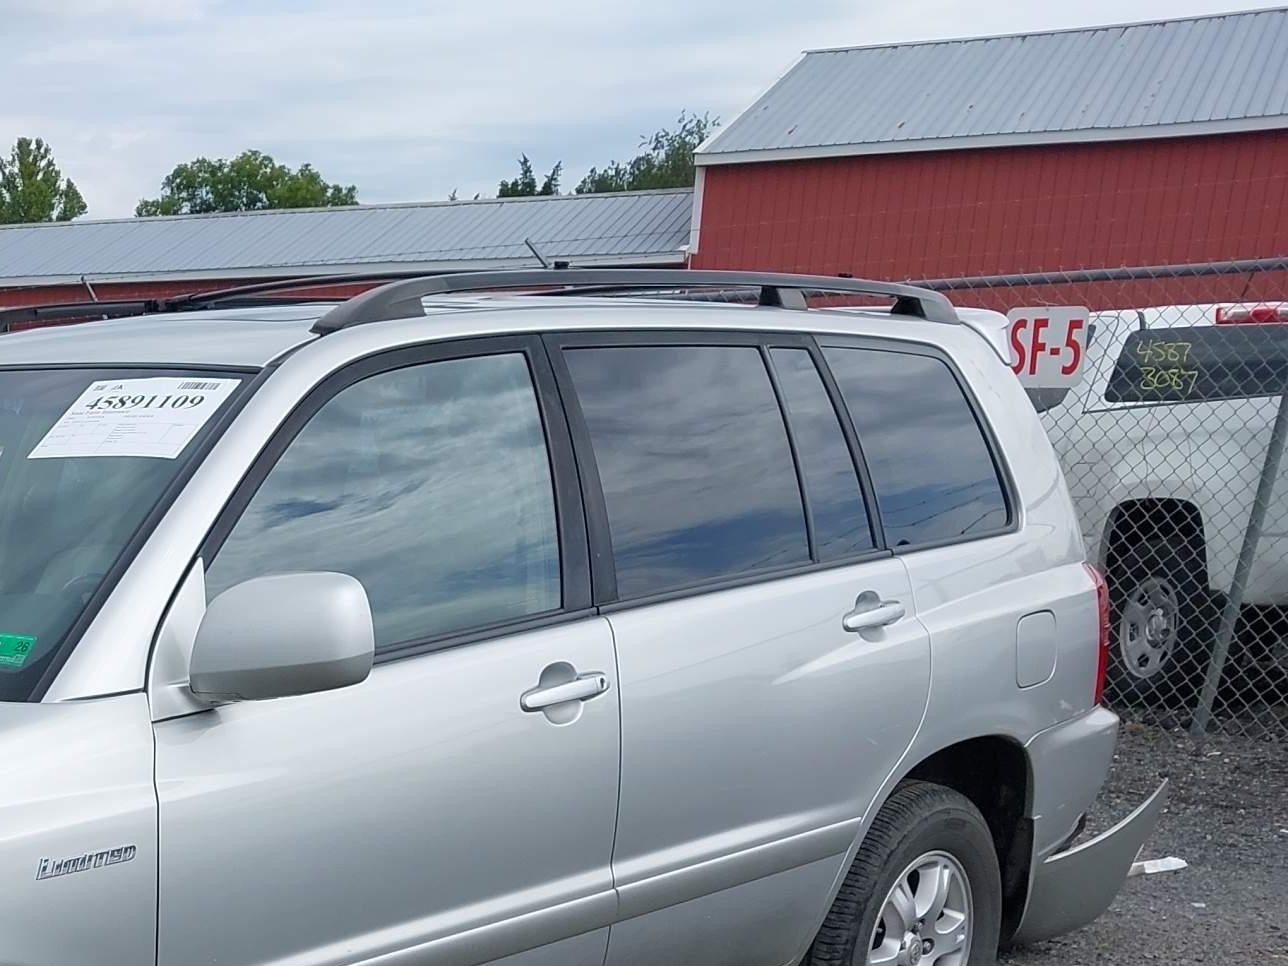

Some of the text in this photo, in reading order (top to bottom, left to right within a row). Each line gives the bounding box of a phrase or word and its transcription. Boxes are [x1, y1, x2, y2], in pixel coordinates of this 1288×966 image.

[1011, 317, 1085, 376] SF-5
[1137, 340, 1192, 363] 4587
[1140, 366, 1199, 396] 3087
[86, 395, 205, 410] 45891109
